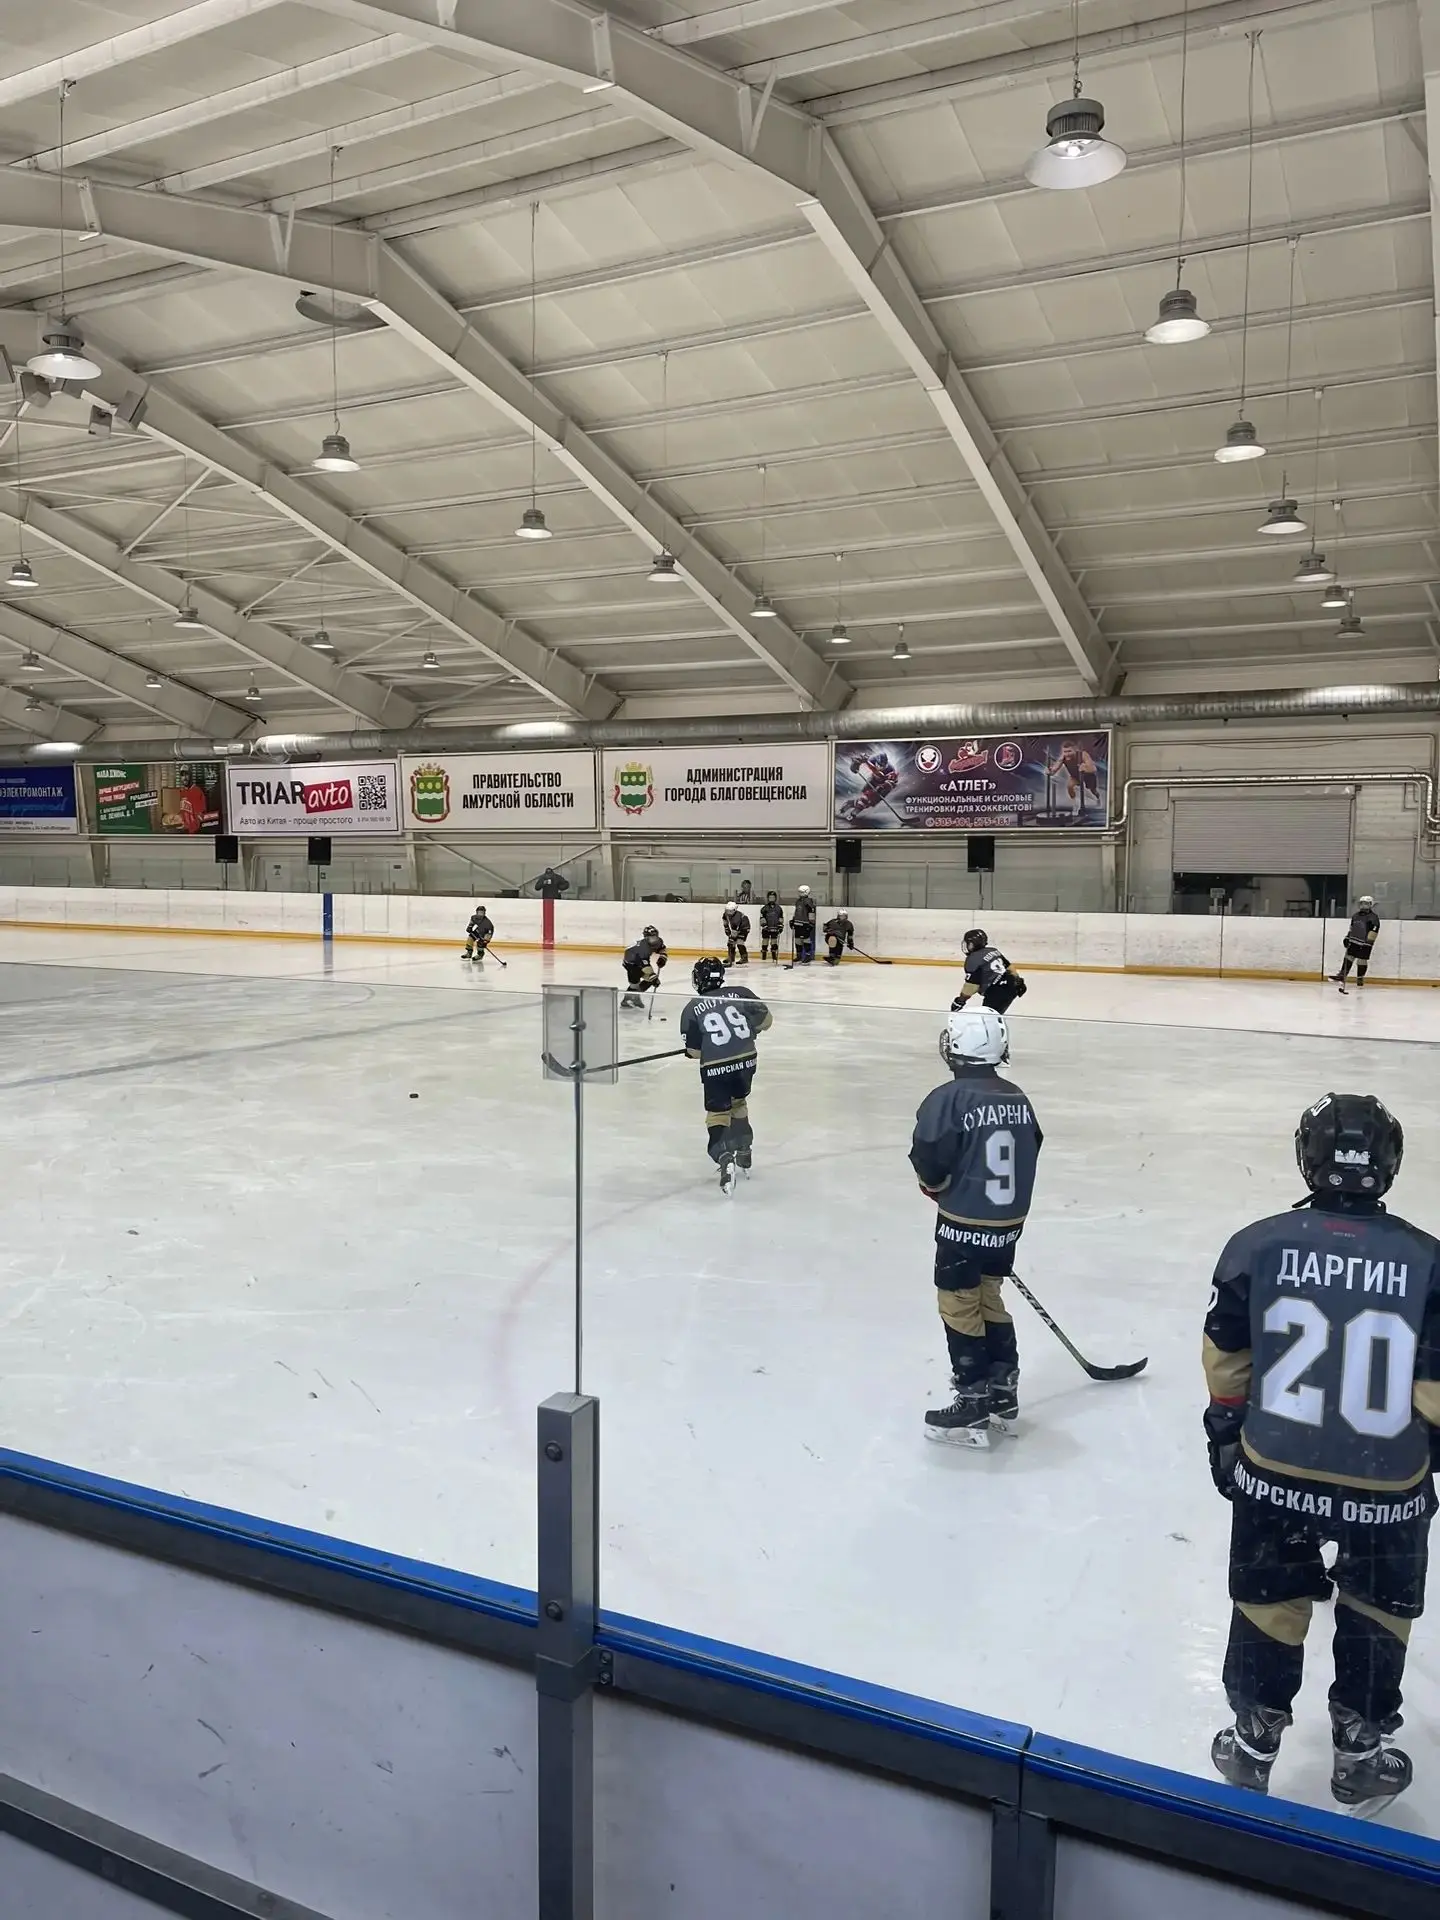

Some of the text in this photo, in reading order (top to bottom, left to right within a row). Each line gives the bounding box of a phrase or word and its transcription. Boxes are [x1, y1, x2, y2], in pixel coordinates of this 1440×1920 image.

[472, 772, 562, 790] ПРАВИТЕЛЬСТВО
[686, 766, 784, 785] АДМИНИСТРАЦИЯ
[236, 780, 350, 808] TRIAR avto
[664, 785, 808, 804] ГОРОДА БЛАГОВЕЩЕНСКА
[939, 779, 997, 792] «АТЛЕТ»
[462, 791, 574, 809] АМУРСКОЙ ОБЛАСТИ
[905, 795, 984, 805] ФУНКЦИОНАЛЬНЫЕ
[991, 794, 1033, 803] СИЛОВЫЕ
[905, 804, 956, 813] ТРЕНИРОВКИ
[956, 804, 974, 814] ДЛЯ
[240, 817, 257, 825] Авто
[267, 817, 287, 825] Китая
[293, 817, 317, 826] проще
[318, 816, 353, 826] простого
[703, 1005, 751, 1046] 99
[706, 1061, 744, 1077] АМУРСКАЯ
[985, 1130, 1016, 1206] 9
[937, 1223, 1005, 1248] АМУРСКАЯ
[1276, 1248, 1408, 1298] ДАРГИН
[1260, 1295, 1418, 1439] 20
[1342, 1492, 1426, 1525] ОБЛАСТЬ
